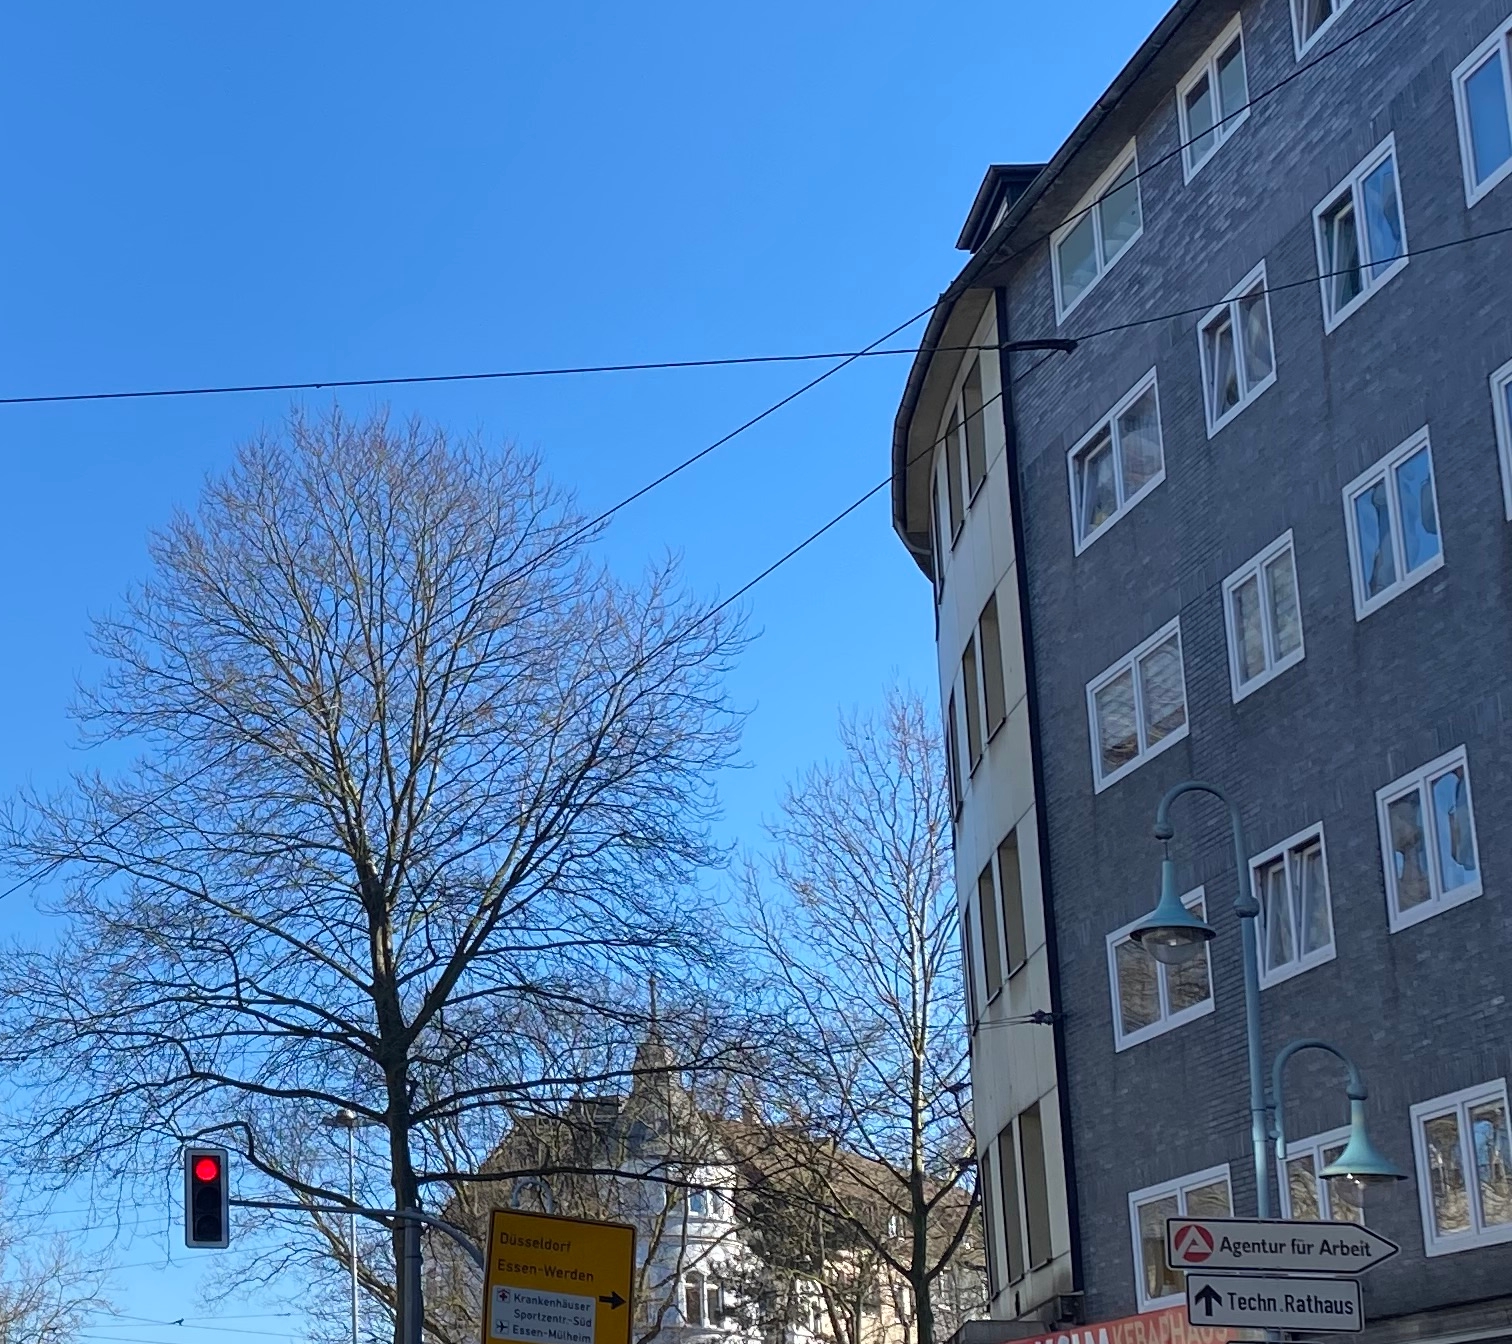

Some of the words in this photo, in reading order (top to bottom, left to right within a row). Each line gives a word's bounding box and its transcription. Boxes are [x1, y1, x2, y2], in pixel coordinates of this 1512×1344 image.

[500, 1232, 571, 1253] Düsseldorf
[1220, 1236, 1286, 1258] Agentur
[1291, 1238, 1314, 1256] für
[1319, 1239, 1372, 1257] Arbeit
[498, 1258, 594, 1283] Essen-Werden
[513, 1293, 592, 1312] Krankenhäuser
[1227, 1292, 1284, 1313] Techn.
[1284, 1294, 1354, 1316] Rathaus
[513, 1309, 592, 1328] Sportzentr.-Süd
[512, 1324, 592, 1344] Essen-Mülheim
